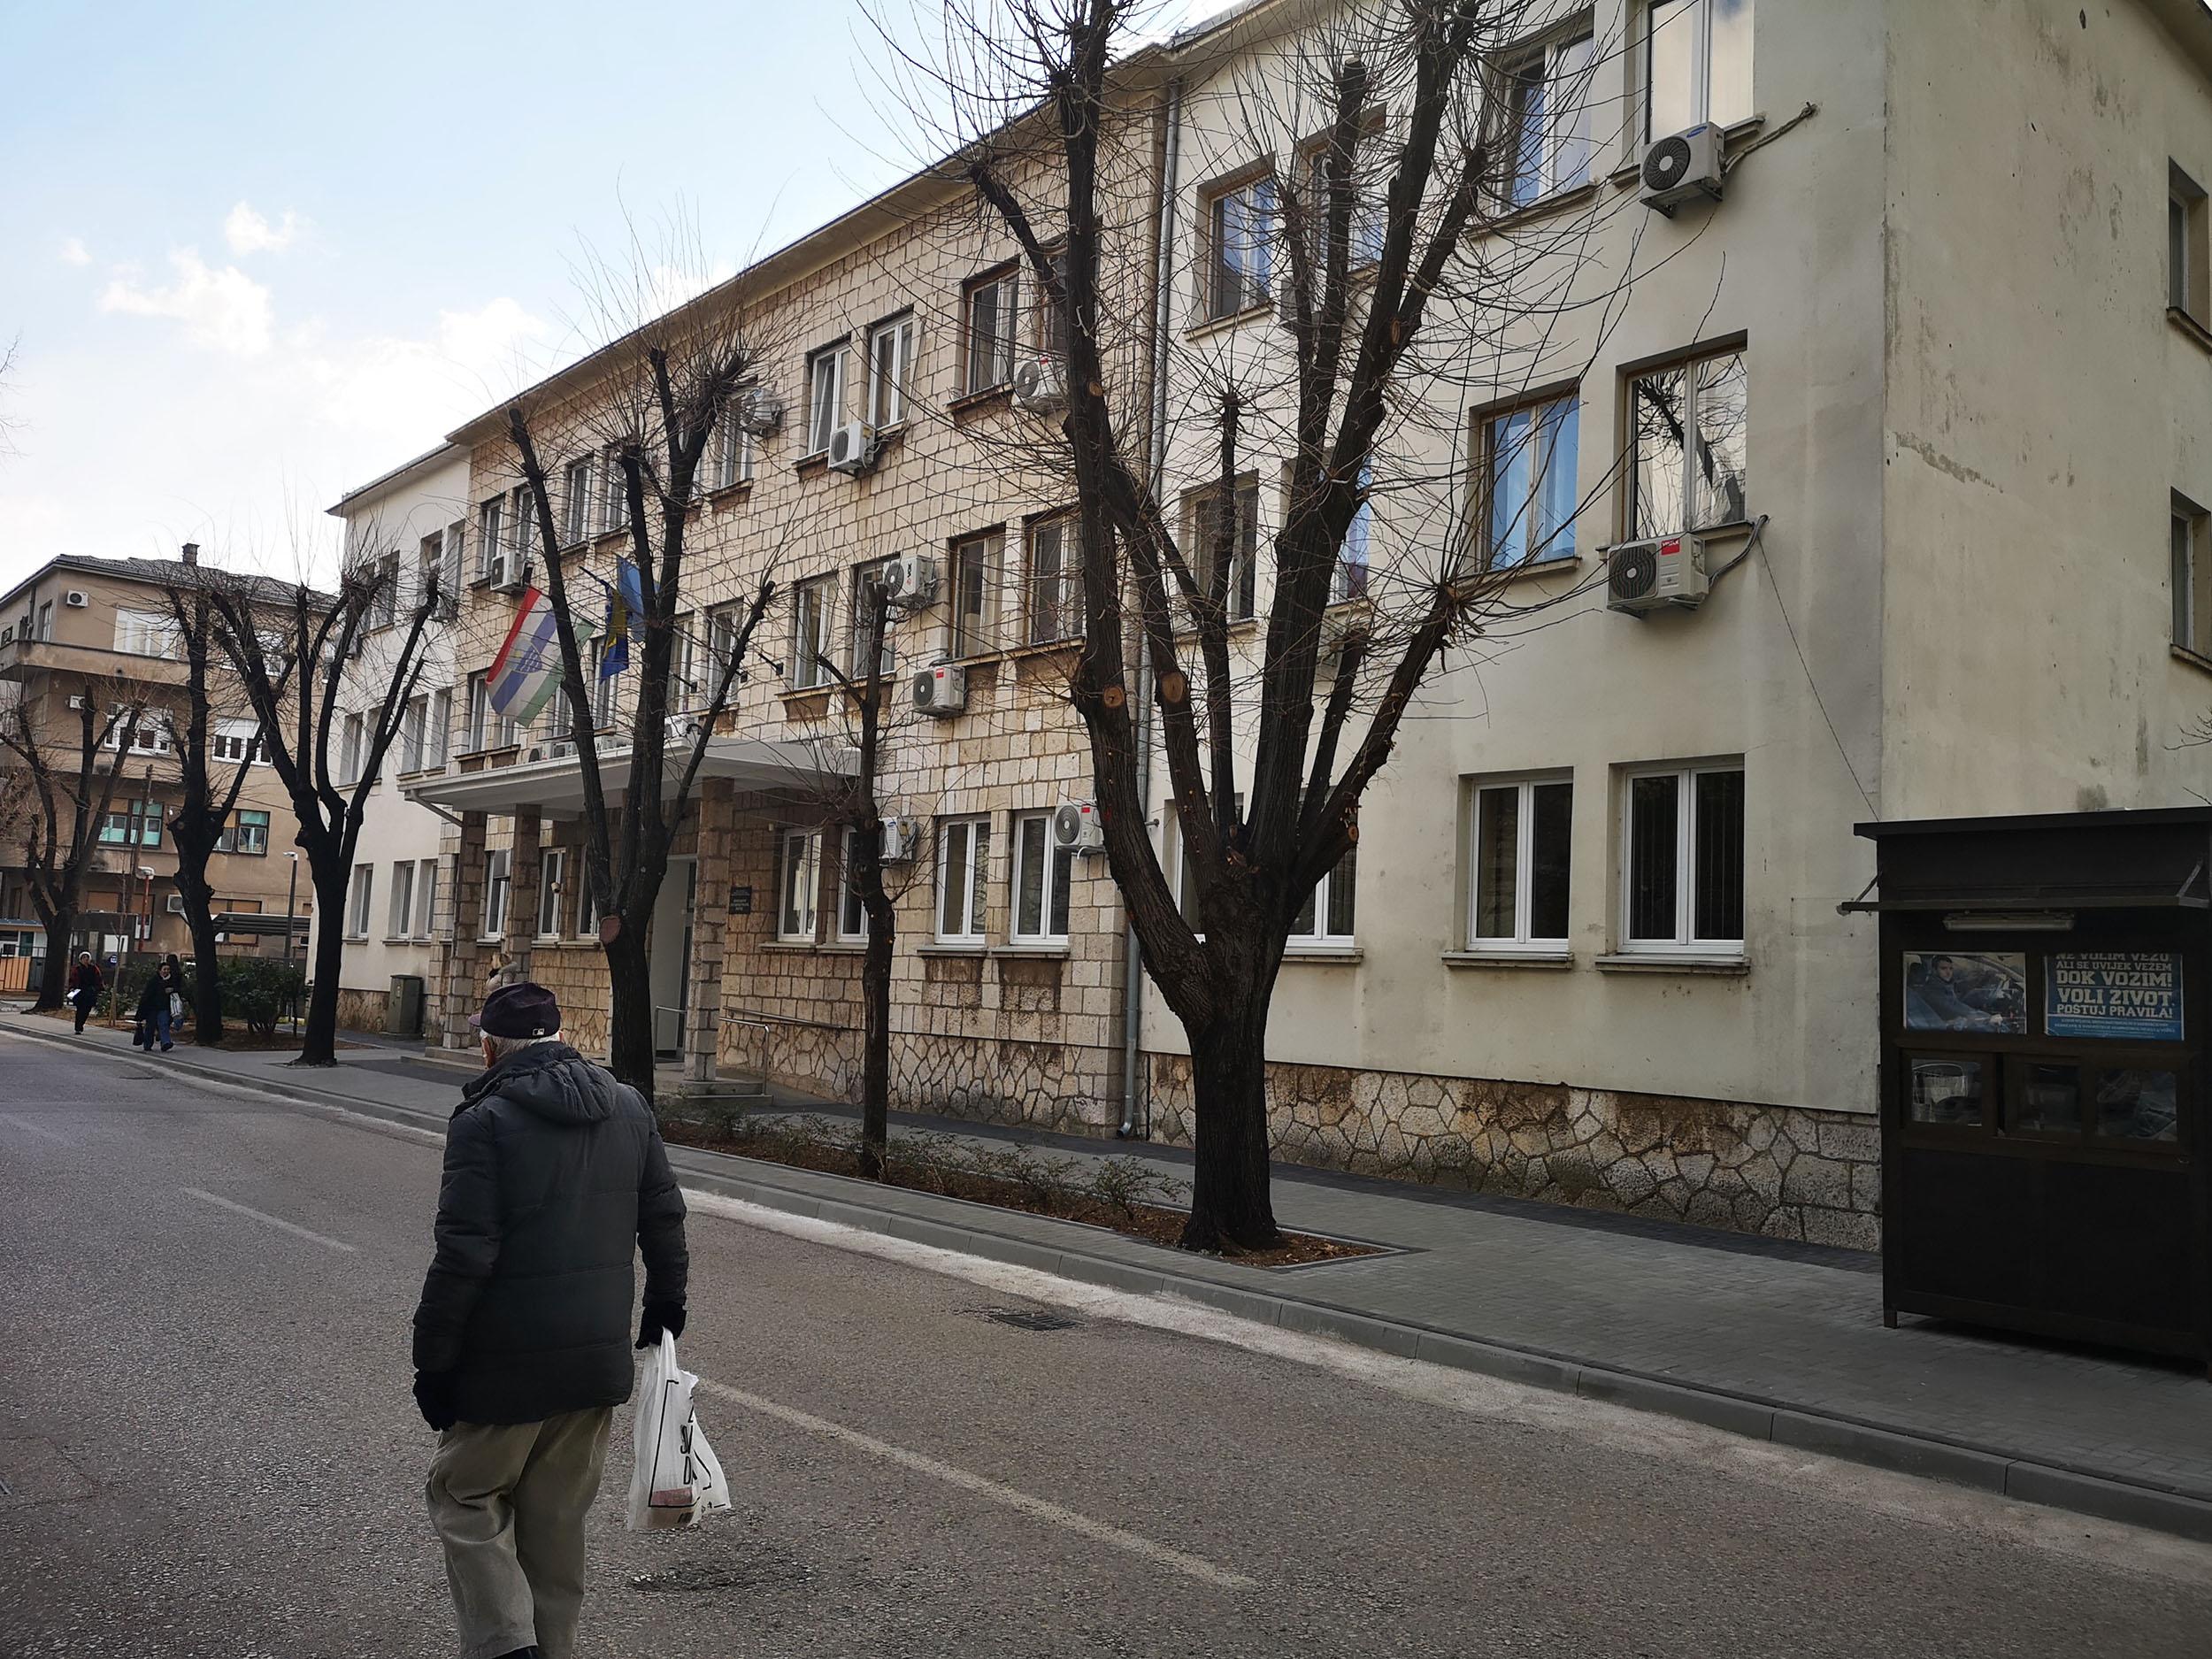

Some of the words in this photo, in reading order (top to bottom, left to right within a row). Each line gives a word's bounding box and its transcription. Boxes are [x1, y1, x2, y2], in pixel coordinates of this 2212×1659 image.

[2056, 969, 2095, 985] DOK
[2101, 971, 2172, 987] VOZIM!
[2057, 988, 2103, 1003] VOLI
[2109, 1005, 2172, 1018] PRAVILA!
